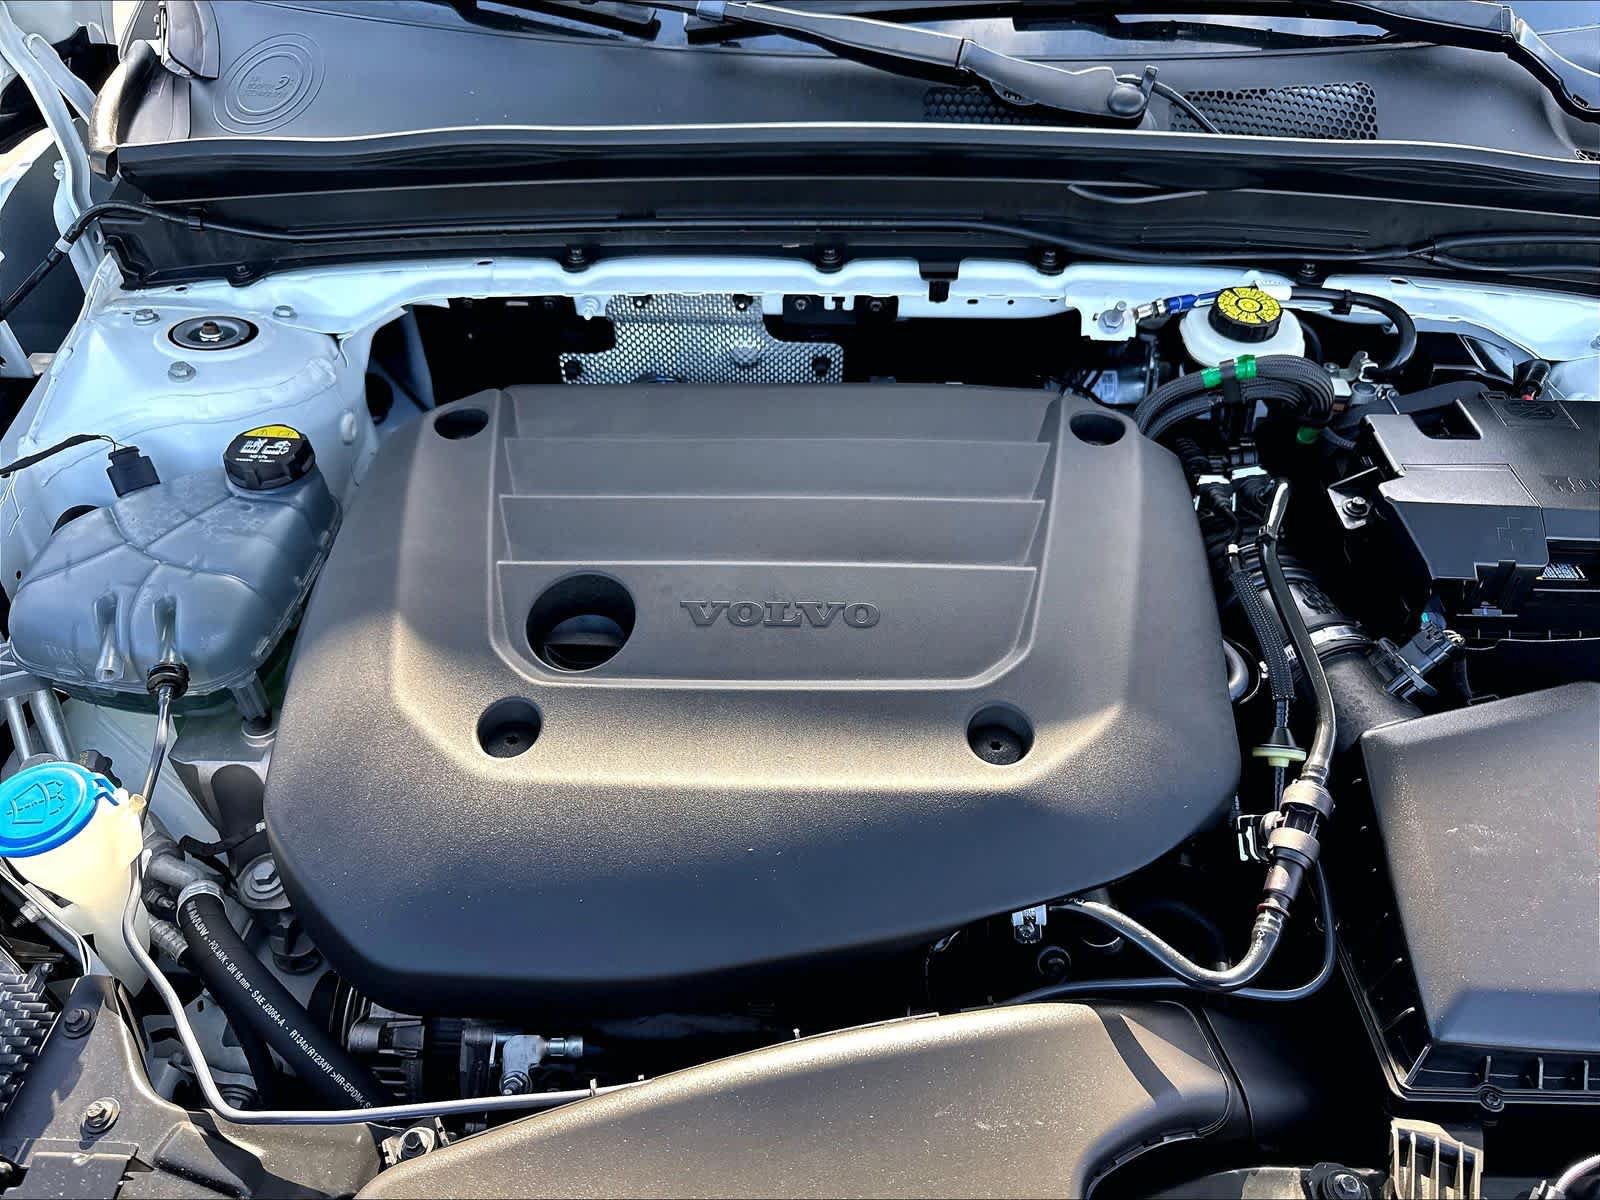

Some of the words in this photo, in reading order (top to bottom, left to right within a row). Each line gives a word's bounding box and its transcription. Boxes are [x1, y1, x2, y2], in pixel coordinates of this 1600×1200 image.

[680, 600, 880, 627] VOLVO
[227, 962, 238, 974] DN
[233, 971, 244, 980] 16
[239, 977, 250, 990] mm
[251, 990, 266, 1006] SAE
[262, 1003, 286, 1027] J2064-A
